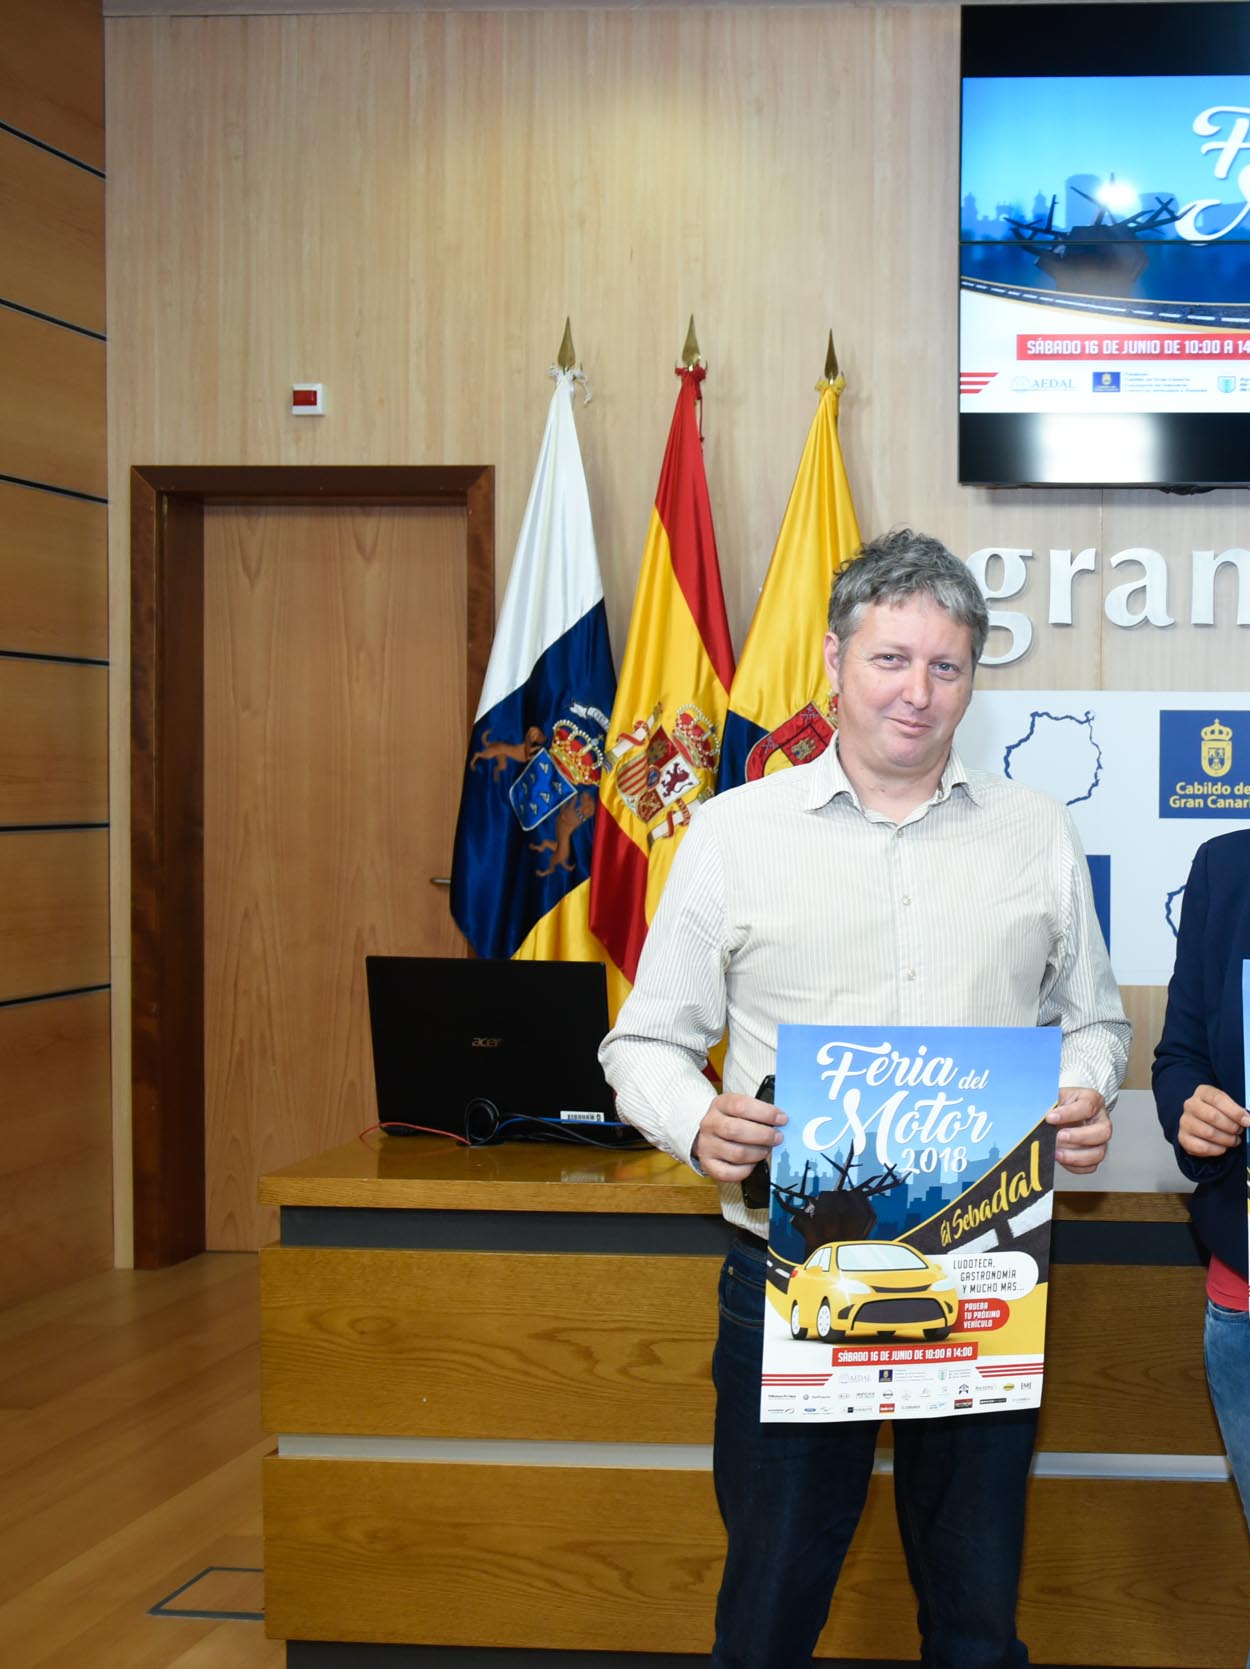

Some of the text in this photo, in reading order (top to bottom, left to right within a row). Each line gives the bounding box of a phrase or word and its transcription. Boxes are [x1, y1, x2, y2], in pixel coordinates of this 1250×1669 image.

[1027, 337, 1081, 354] SÁBADO
[1084, 340, 1099, 354] 16
[1103, 340, 1120, 354] DE
[1122, 340, 1160, 355] JUNIO
[1164, 340, 1181, 354] DE
[1184, 340, 1220, 354] 10:00
[1224, 340, 1233, 354] A
[1176, 782, 1231, 795] Cabildo
[1169, 795, 1204, 808] Gran
[472, 1037, 504, 1047] acer
[817, 1041, 990, 1100] Feria del
[802, 1088, 993, 1168] Motor
[899, 1146, 967, 1174] 2018
[952, 1140, 1043, 1239] Sebadal
[953, 1258, 996, 1269] LUDOTECA,
[960, 1268, 1017, 1281] GASTRONOMÍA
[963, 1284, 967, 1293] Y
[970, 1283, 998, 1293] MUCHO
[964, 1302, 989, 1311] PRUEBA
[964, 1310, 1001, 1320] TU PRÓXIMO
[963, 1319, 993, 1329] VEHÍCULO
[838, 1346, 973, 1362] SÁBADO 16 DE JUNIO DE 10:00 A 14:00
